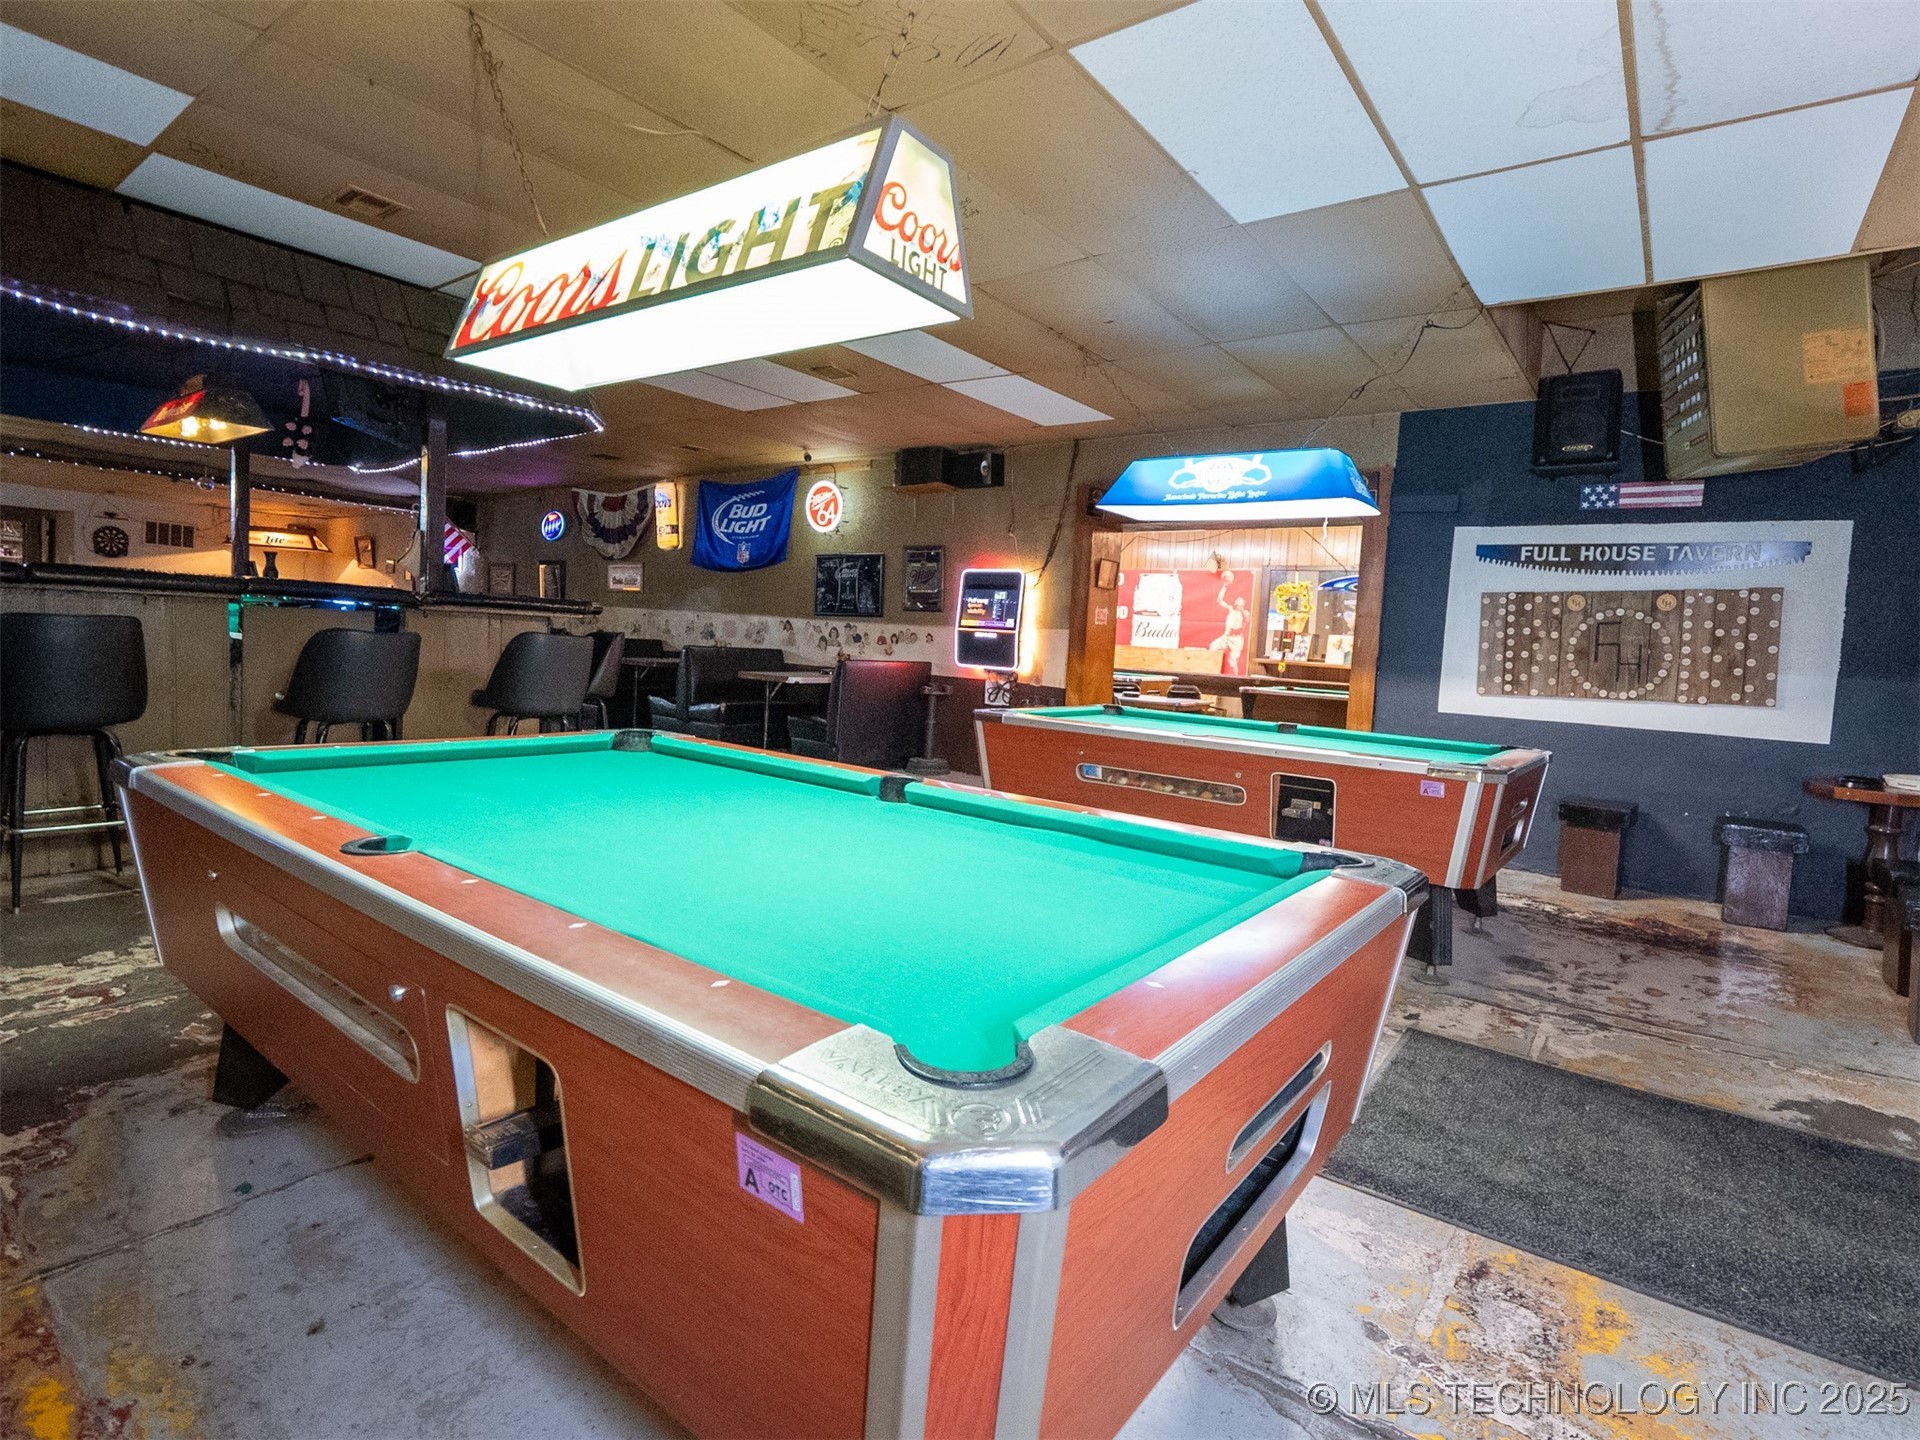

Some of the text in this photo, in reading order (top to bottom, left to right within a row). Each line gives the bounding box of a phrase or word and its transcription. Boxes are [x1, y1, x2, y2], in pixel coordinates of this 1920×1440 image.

[874, 181, 962, 272] Coors
[456, 180, 860, 347] Coors LIGHT
[890, 238, 948, 291] LIGHT
[720, 515, 772, 534] LIGHT
[728, 503, 768, 519] BUD
[817, 501, 837, 526] 64
[1520, 544, 1762, 562] FULL HOUSE TAVERN
[744, 1167, 760, 1194] A
[768, 1181, 788, 1201] OTC
